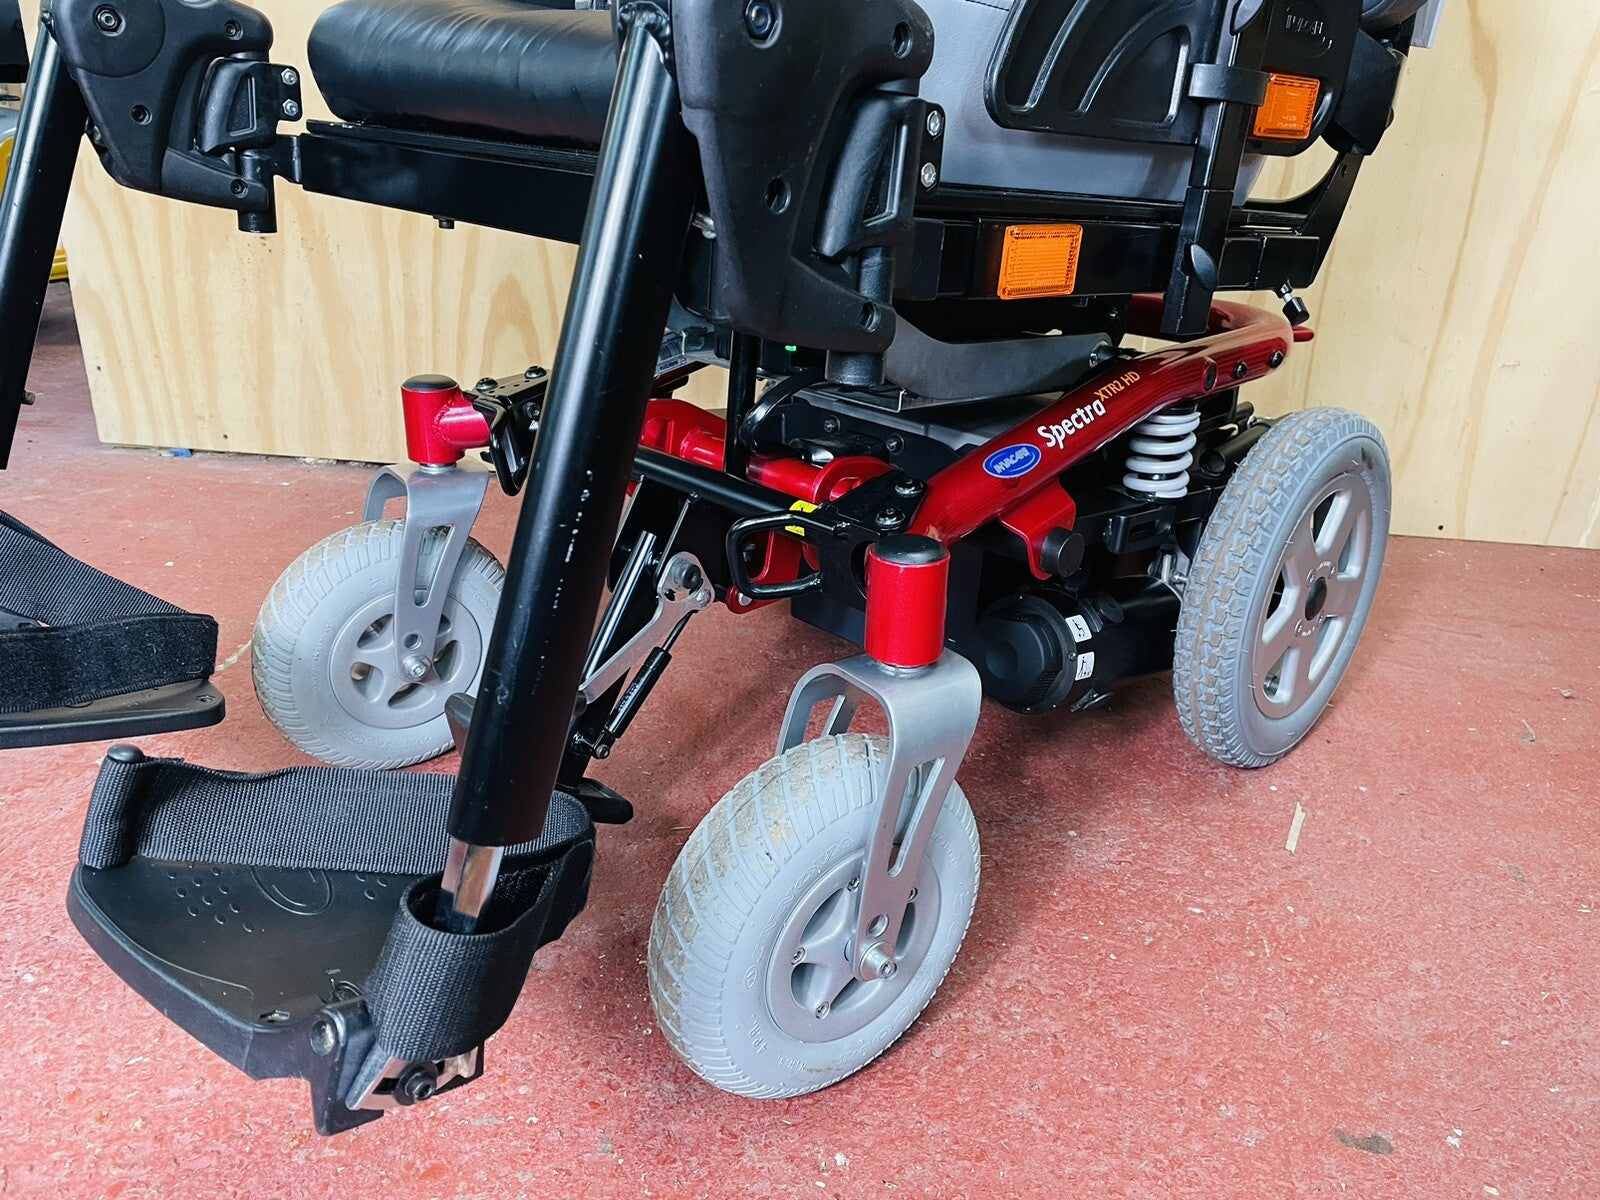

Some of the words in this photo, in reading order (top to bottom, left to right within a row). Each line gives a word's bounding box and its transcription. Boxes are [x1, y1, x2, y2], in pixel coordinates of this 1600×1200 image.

[1037, 400, 1106, 449] Spectra
[1094, 380, 1125, 402] XTR2
[1121, 371, 1141, 387] HD
